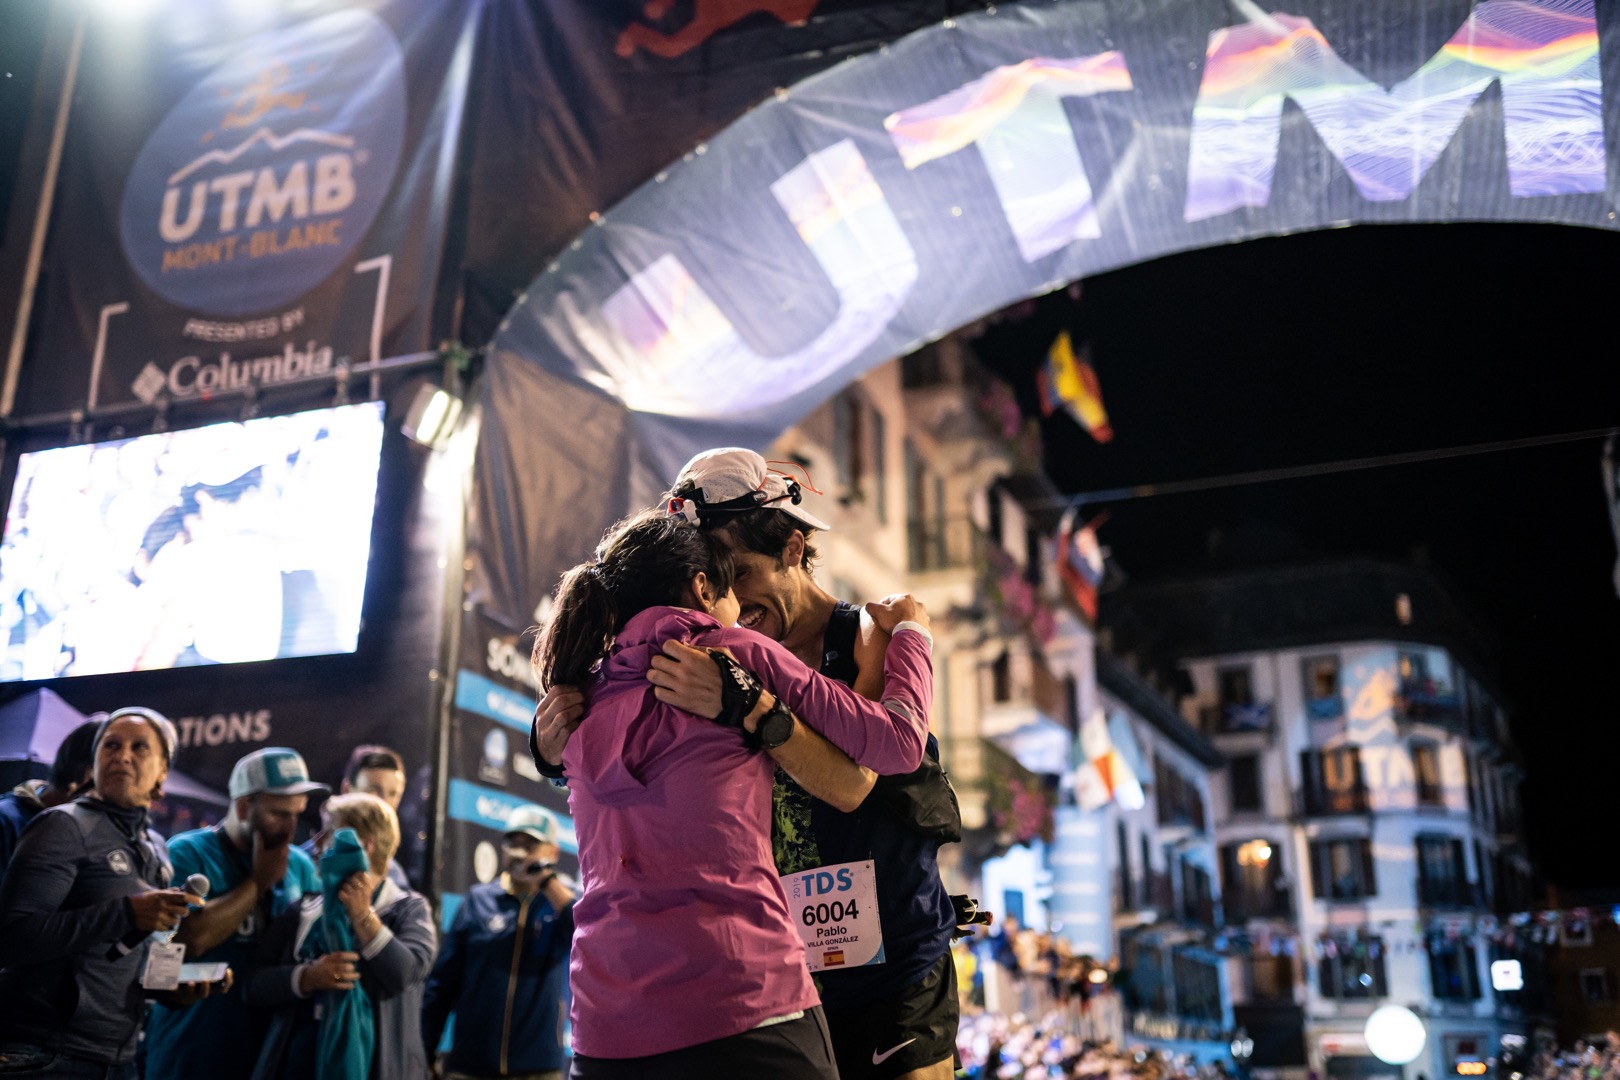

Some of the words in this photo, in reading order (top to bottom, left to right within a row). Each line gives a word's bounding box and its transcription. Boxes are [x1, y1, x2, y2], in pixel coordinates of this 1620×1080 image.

[159, 153, 356, 243] UTMB
[168, 340, 333, 396] Columbia
[172, 708, 272, 748] TIONS
[801, 868, 852, 897] TDS
[802, 899, 859, 926] 6004
[807, 940, 824, 948] VILLA
[825, 935, 859, 946] GONZÁLEZ
[816, 926, 847, 938] Pablo
